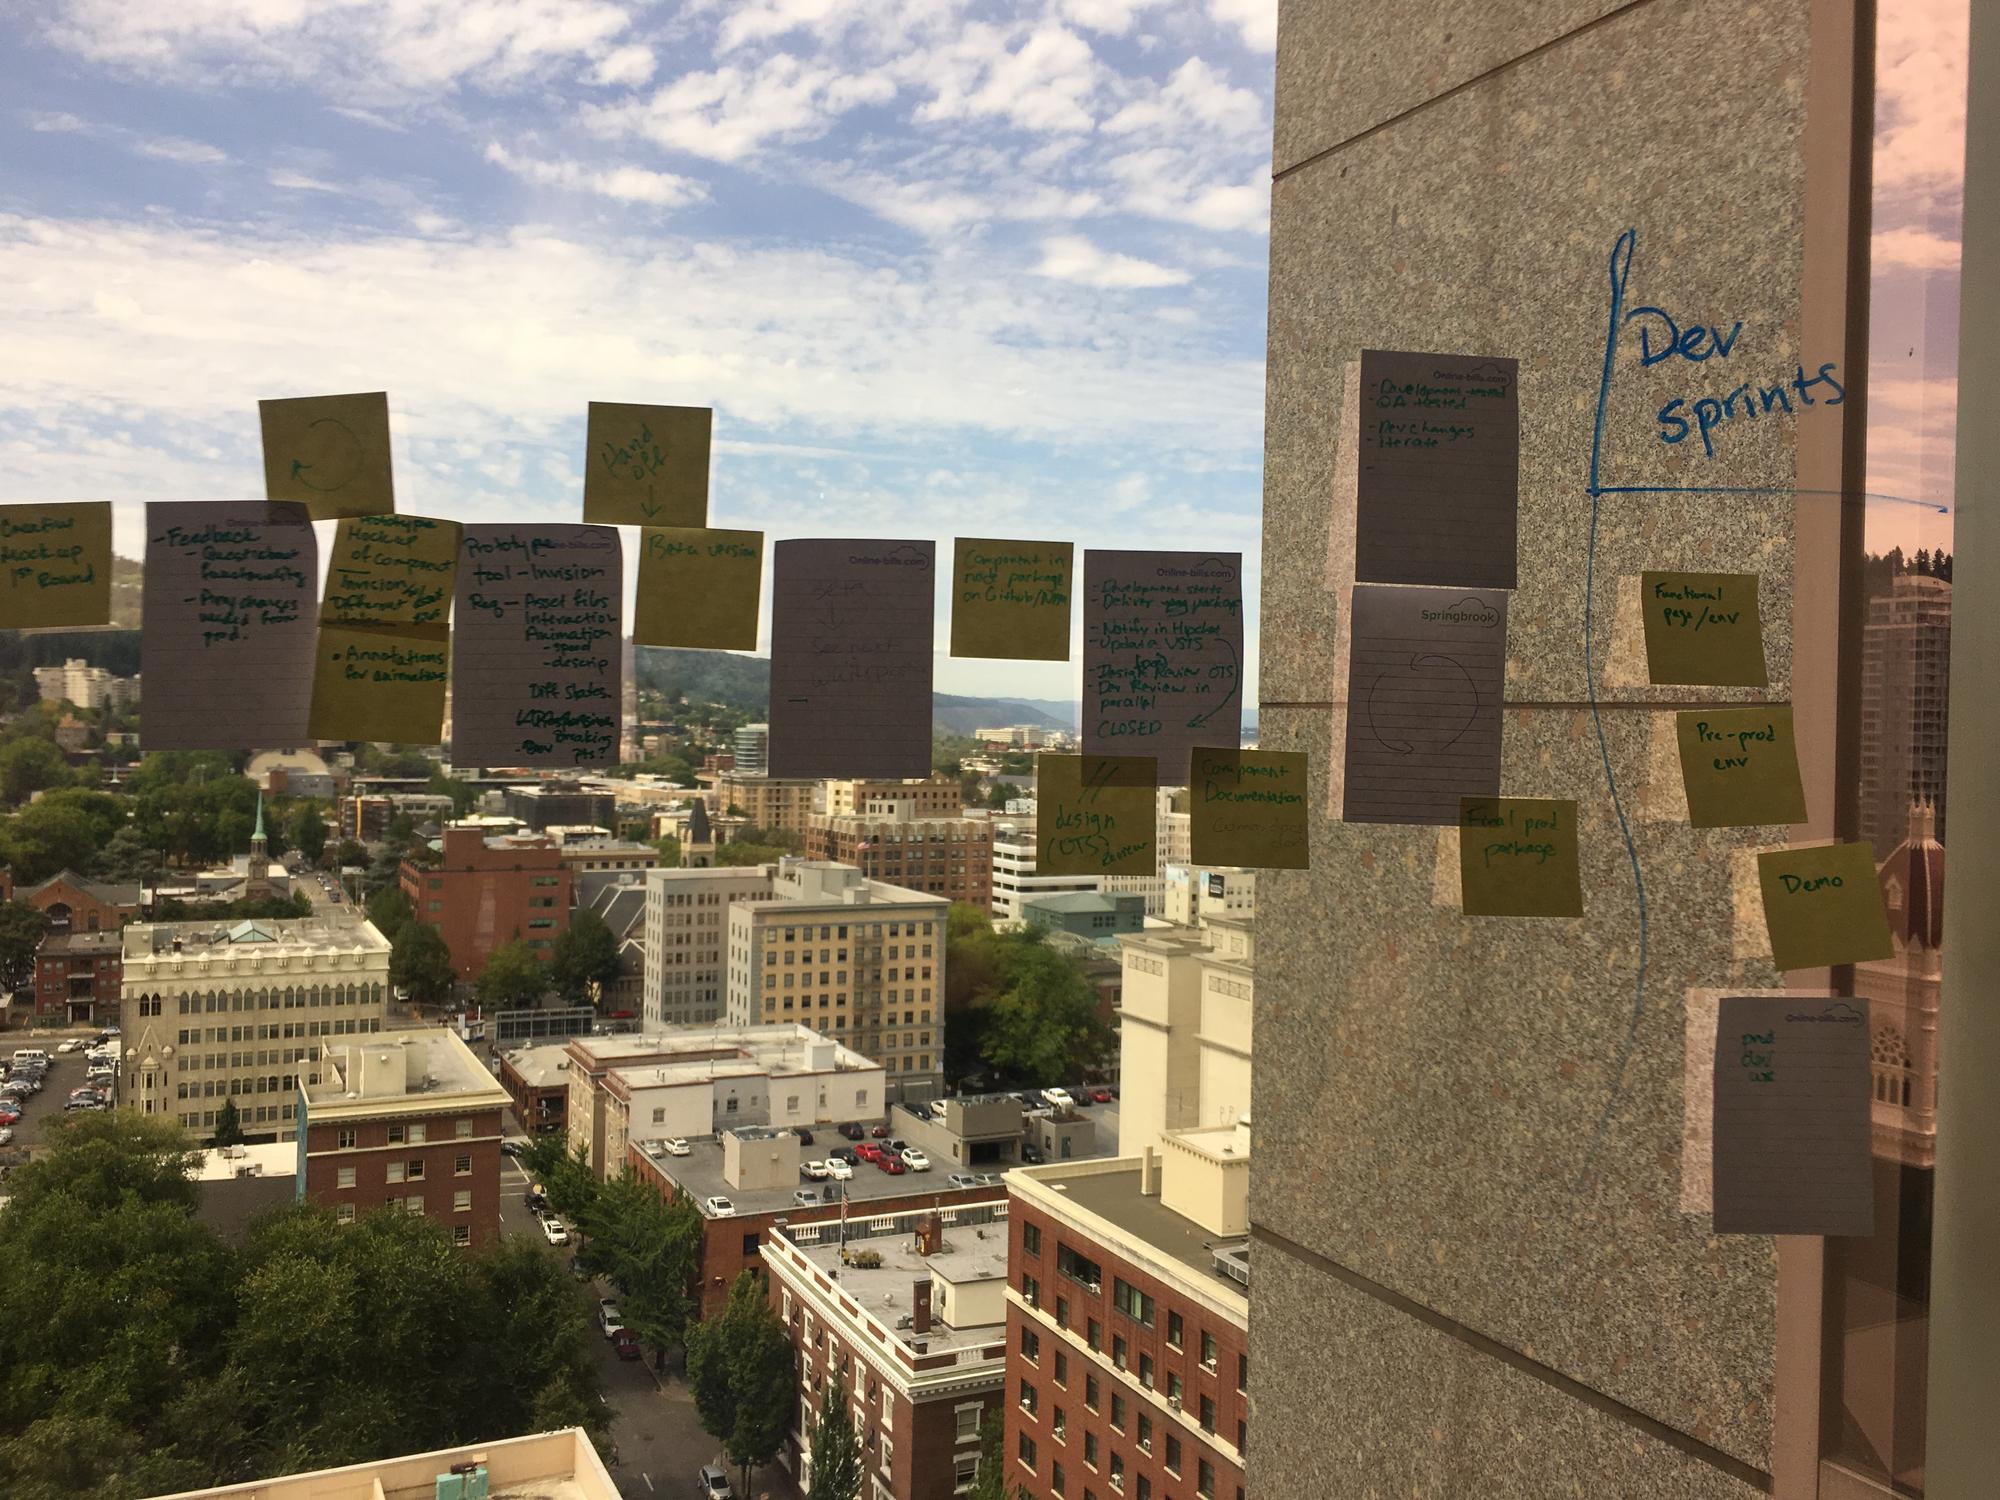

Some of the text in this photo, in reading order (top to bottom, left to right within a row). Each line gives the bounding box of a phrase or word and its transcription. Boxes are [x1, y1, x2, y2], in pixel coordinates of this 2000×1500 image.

[1626, 306, 1743, 366] Dev
[473, 564, 511, 586] tool
[1156, 567, 1231, 579] Online-bills.com
[1421, 609, 1495, 623] Springbrook
[1155, 622, 1168, 635] in
[1195, 682, 1211, 694] in
[1097, 719, 1162, 739] CLOSED
[1713, 757, 1749, 771] env
[1055, 803, 1116, 836] design
[1778, 873, 1845, 894] Demo
